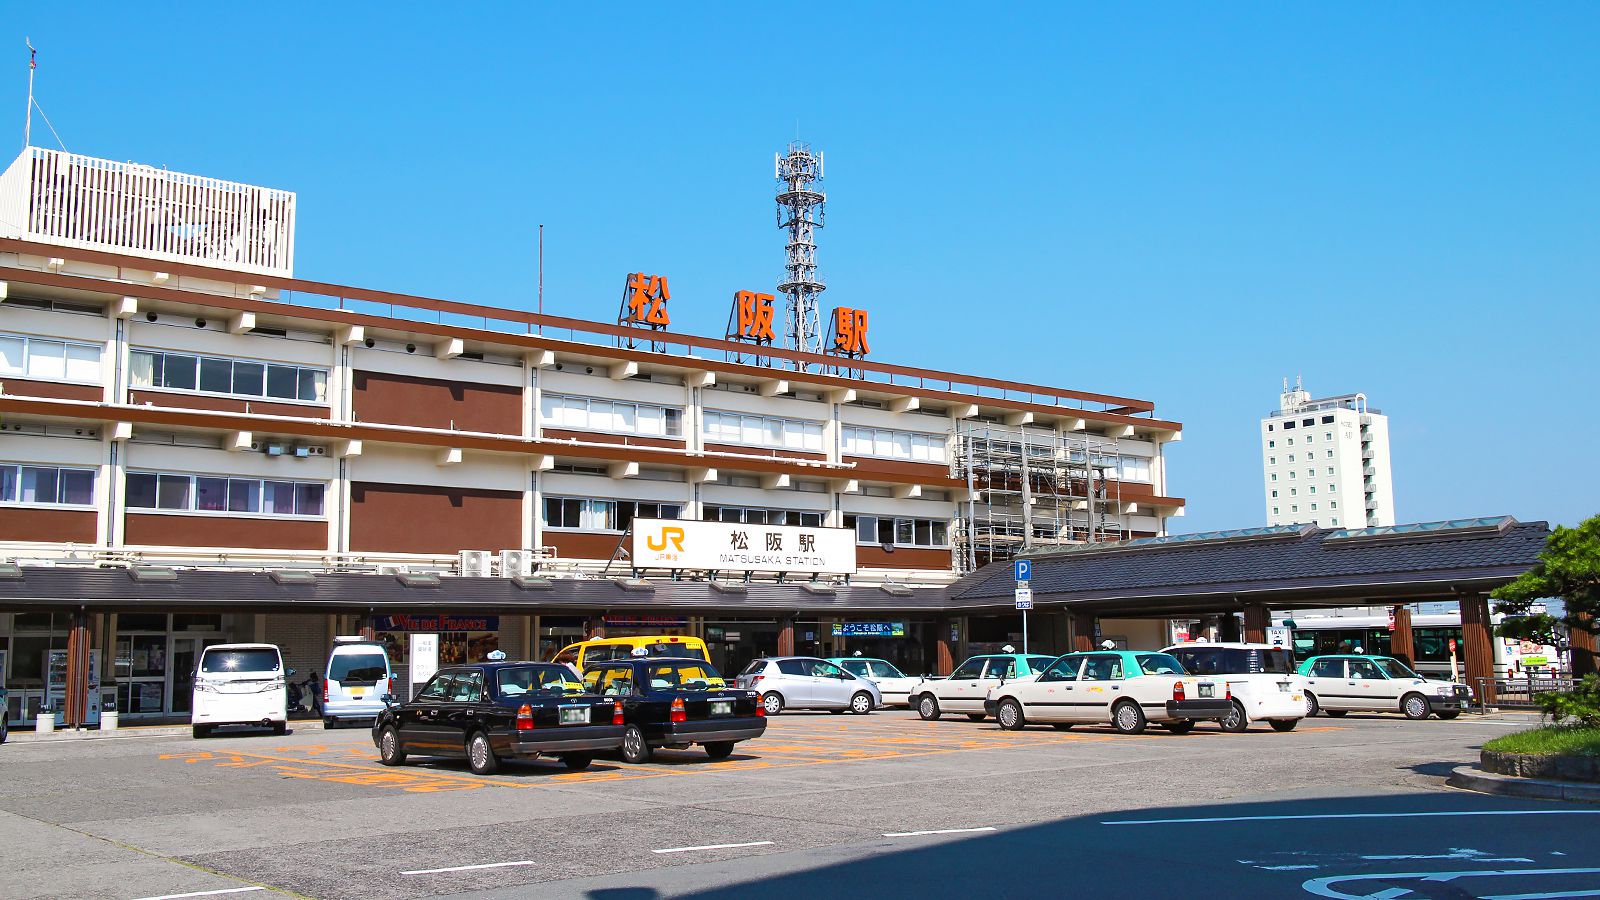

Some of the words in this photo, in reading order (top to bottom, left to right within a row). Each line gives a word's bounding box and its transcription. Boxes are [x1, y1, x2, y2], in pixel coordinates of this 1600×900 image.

[647, 526, 685, 552] JR
[730, 530, 816, 553] 松阪駅
[719, 553, 782, 565] MATSUSAKA
[785, 556, 826, 566] STATION
[1019, 562, 1028, 579] P
